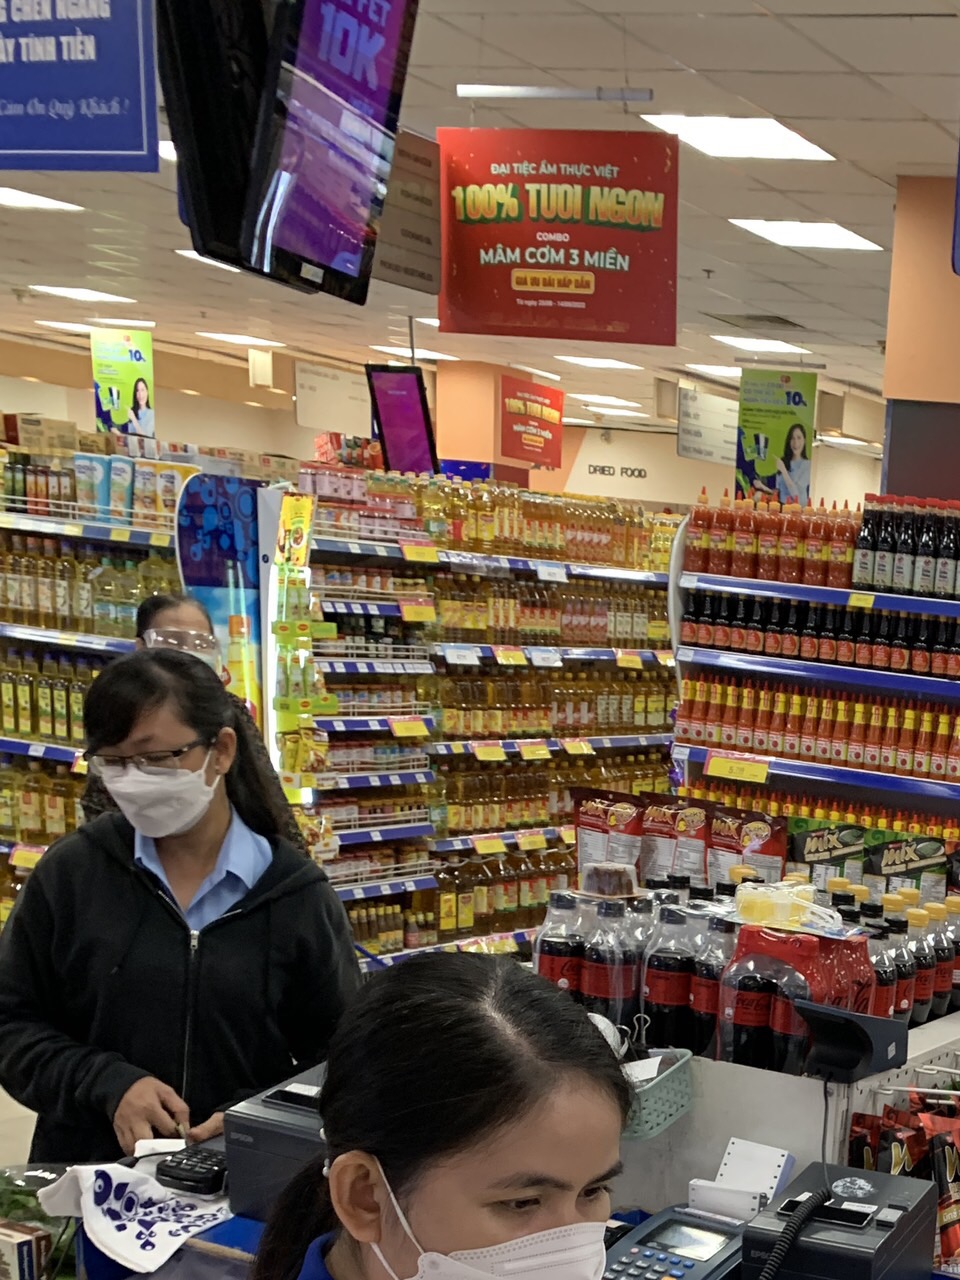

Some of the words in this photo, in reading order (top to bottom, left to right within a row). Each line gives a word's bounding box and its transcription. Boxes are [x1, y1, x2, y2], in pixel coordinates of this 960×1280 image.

[317, 2, 386, 90] 10K
[490, 162, 510, 177] ĐẠI
[559, 163, 591, 179] THỰC
[593, 165, 620, 181] VIỆT
[451, 182, 520, 222] 100%
[588, 185, 665, 228] NGON
[536, 231, 570, 242] COMBO
[479, 243, 521, 265] MÂM
[524, 245, 565, 265] CƠM
[569, 249, 580, 265] 3
[583, 247, 630, 271] MIỀN
[619, 466, 647, 479] FOOD
